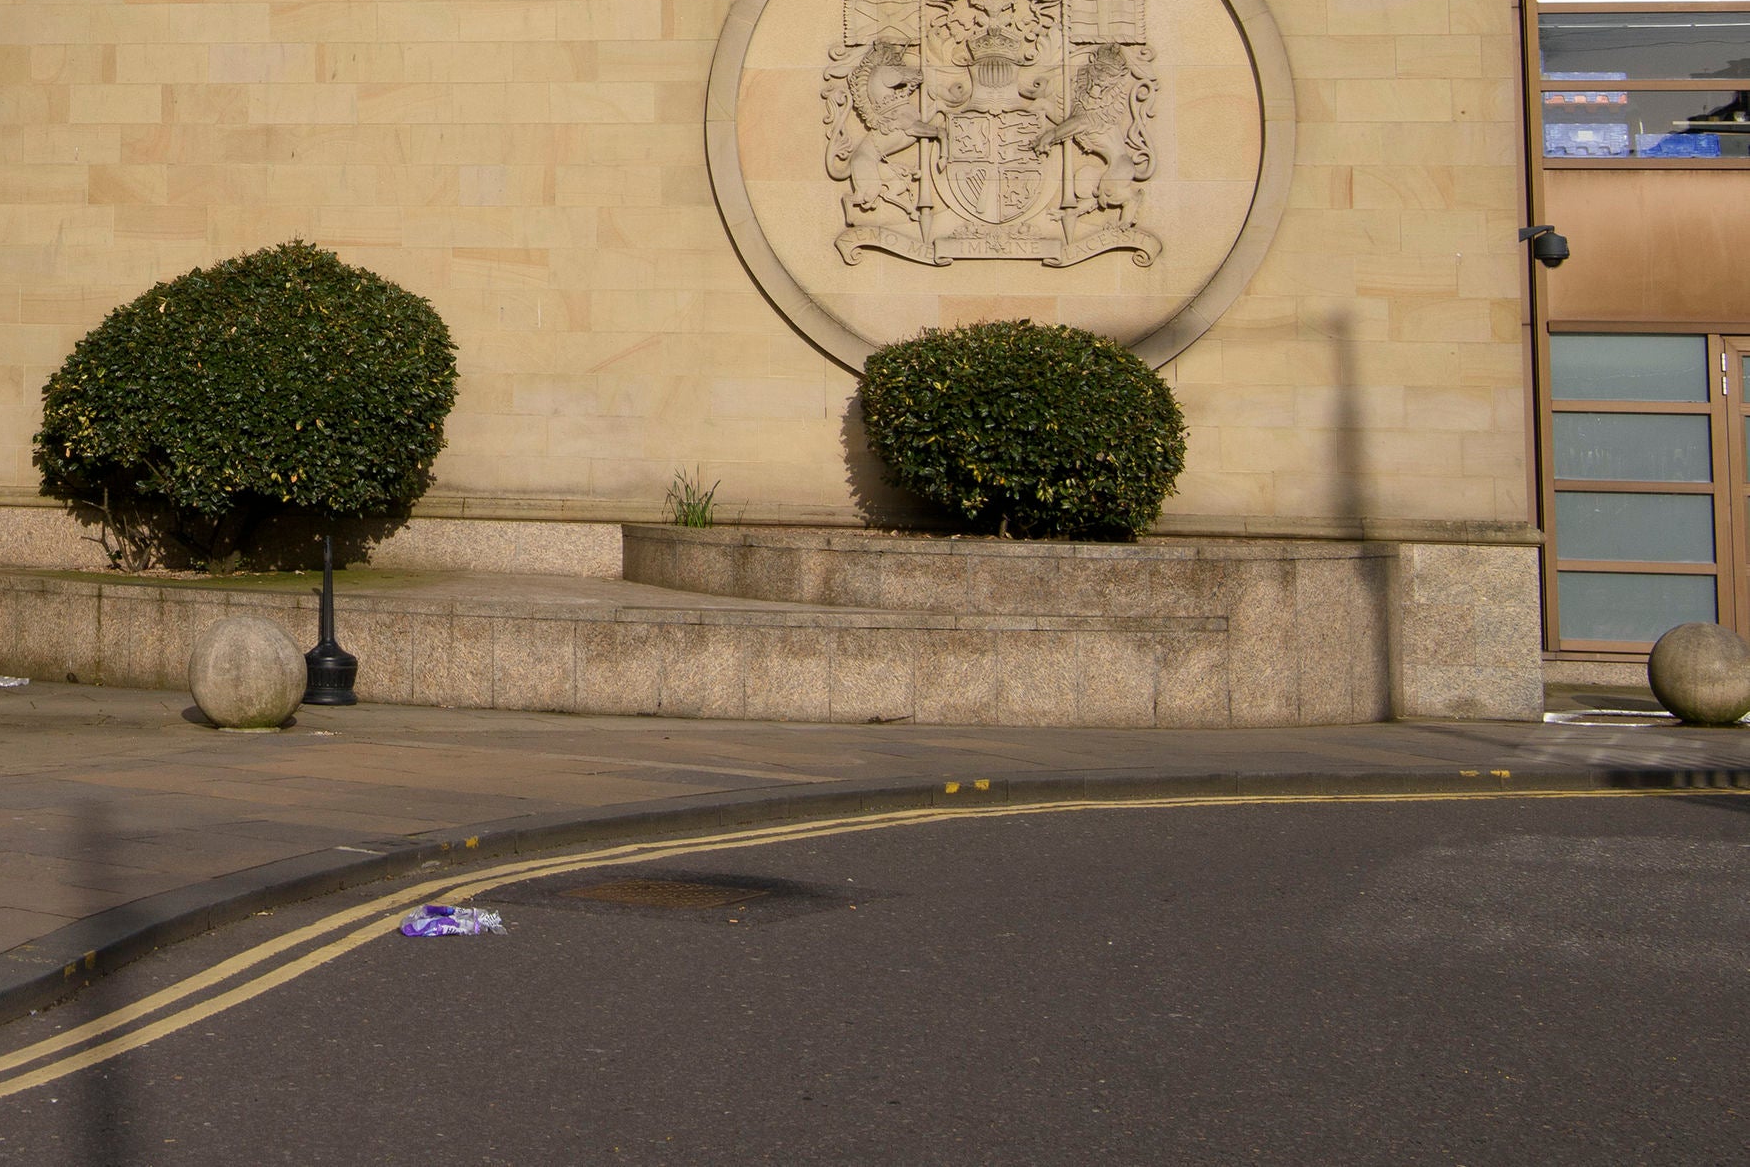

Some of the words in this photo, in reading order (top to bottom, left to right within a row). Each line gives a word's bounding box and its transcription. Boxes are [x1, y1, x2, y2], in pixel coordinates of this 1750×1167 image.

[839, 227, 899, 247] NEMO
[907, 240, 935, 259] ME
[1064, 229, 1150, 258] LACESSIT
